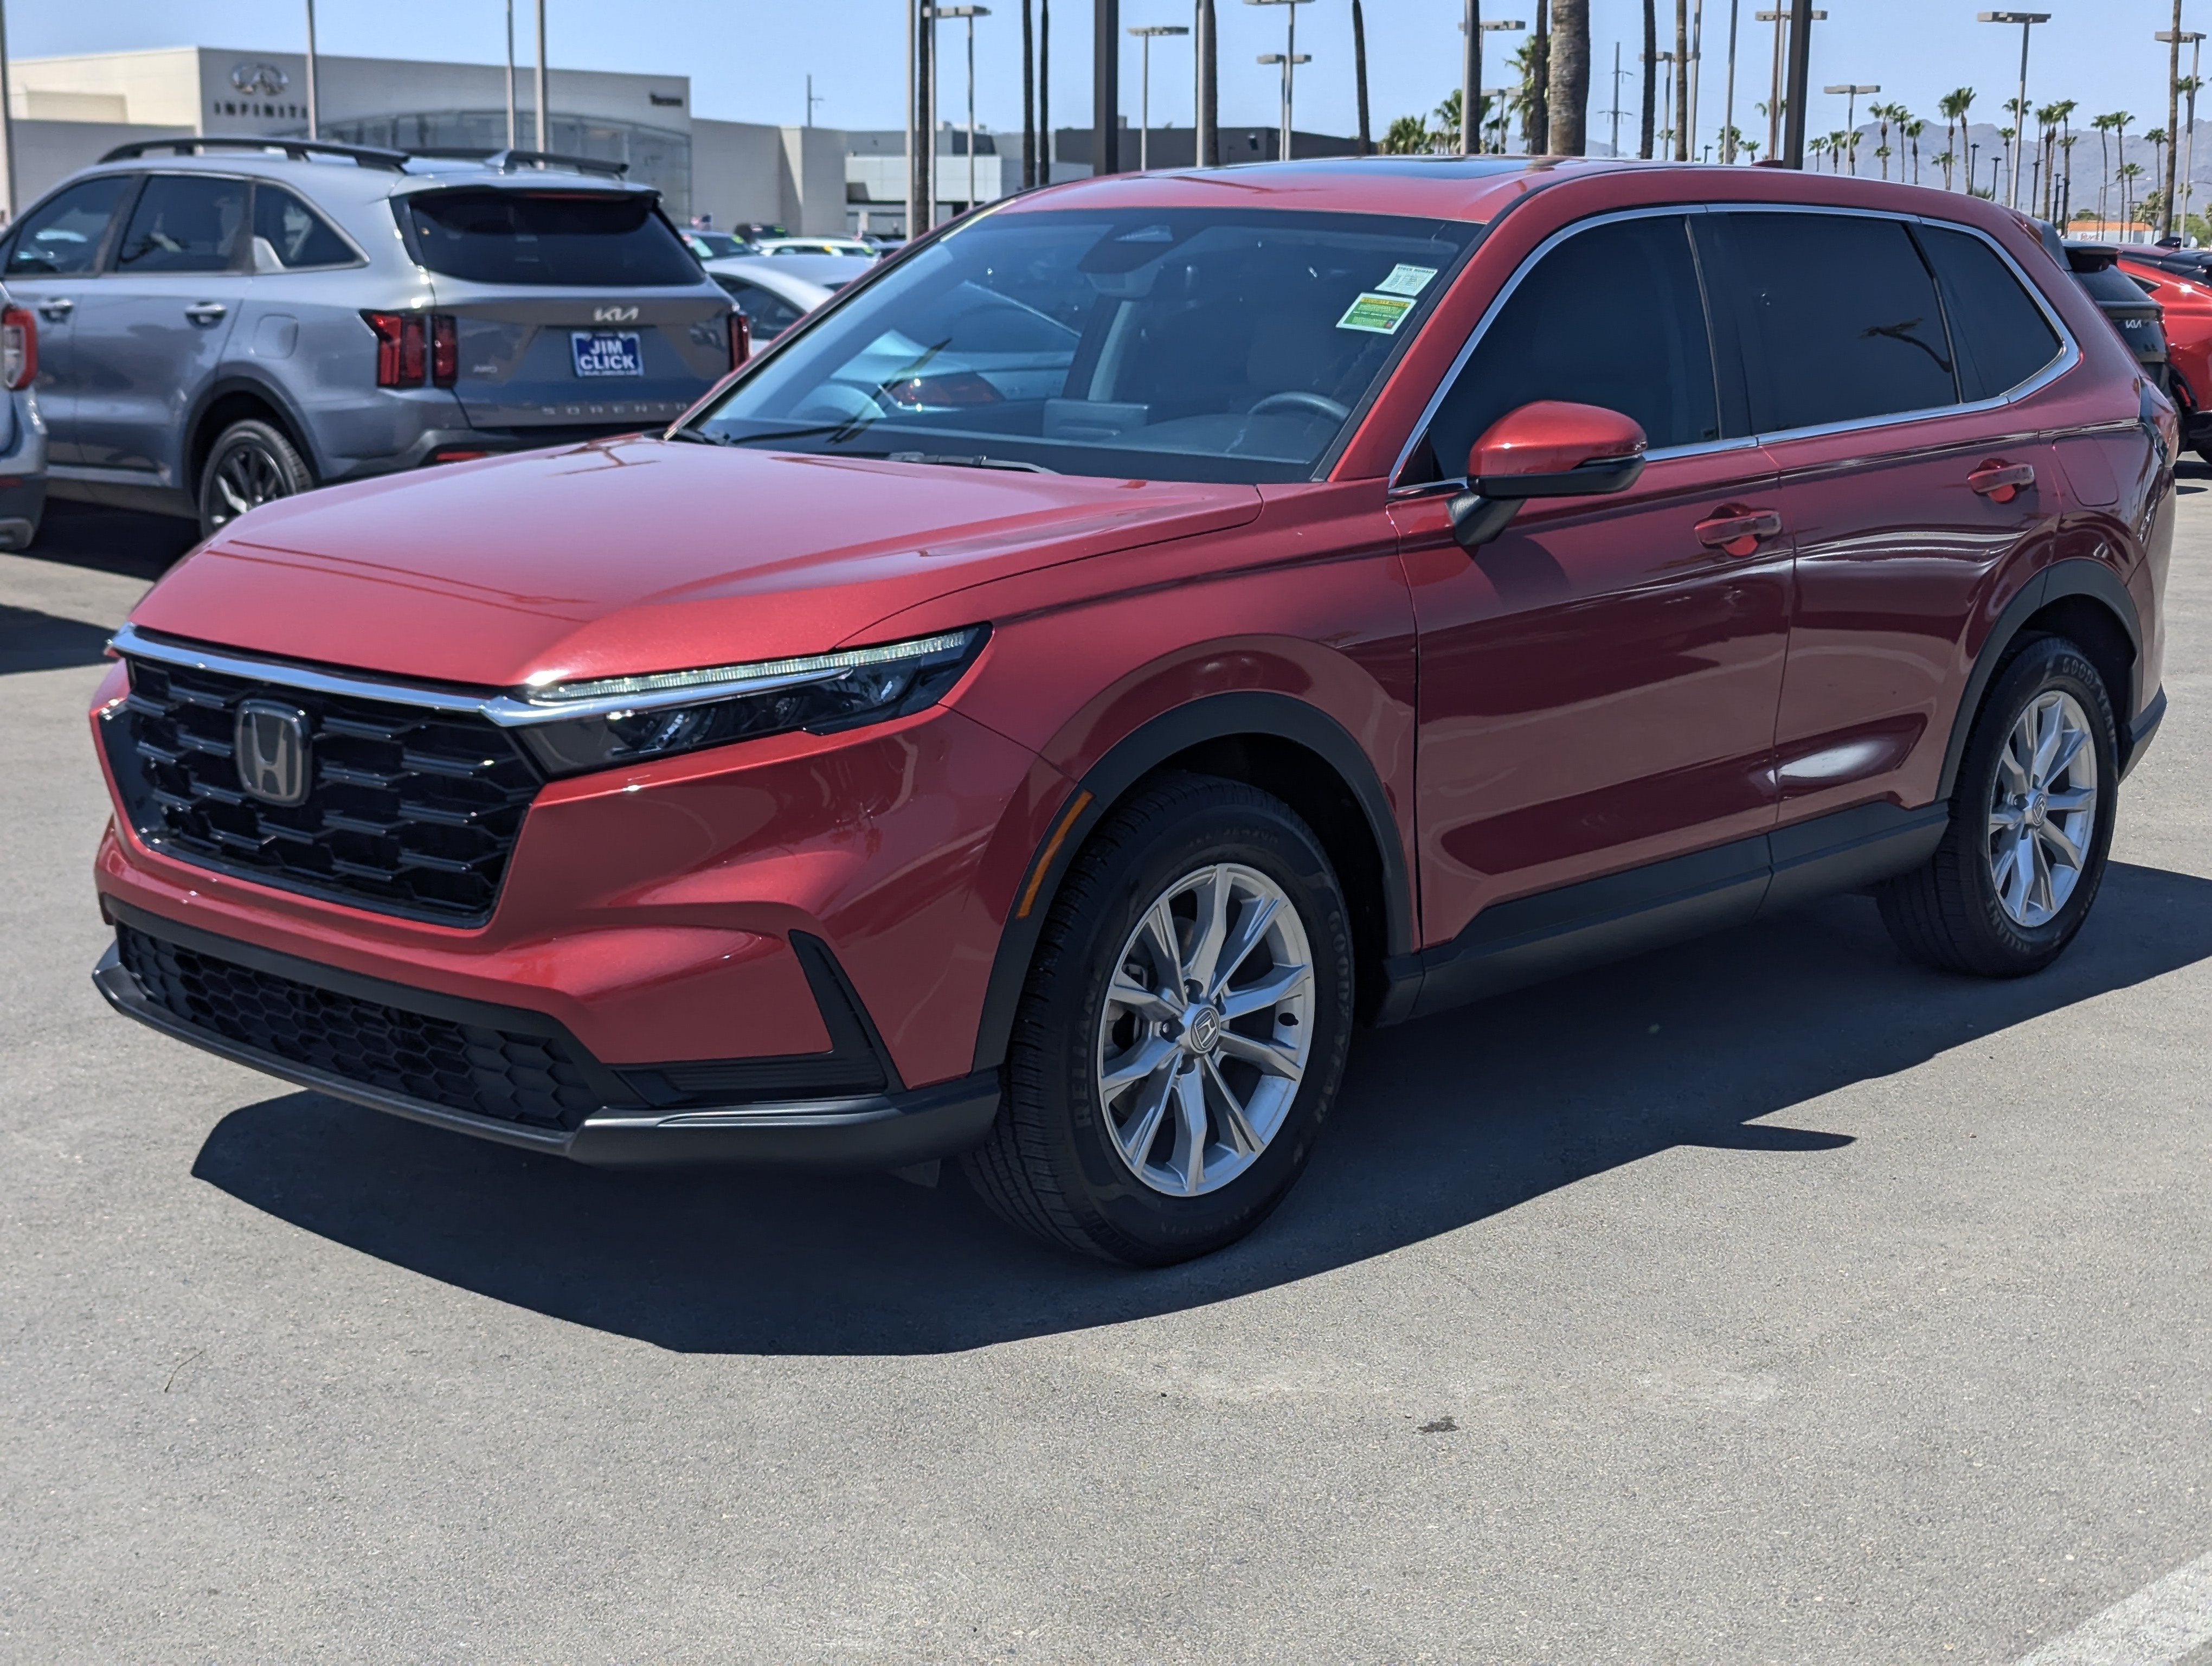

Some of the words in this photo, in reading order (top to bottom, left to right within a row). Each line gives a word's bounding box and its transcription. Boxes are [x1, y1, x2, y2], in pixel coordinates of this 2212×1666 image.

[214, 101, 308, 118] INFINITI
[595, 306, 639, 321] KIA
[2125, 319, 2142, 329] KIA
[590, 340, 623, 355] JIM
[580, 355, 636, 370] CLICK
[542, 402, 688, 415] SORENTO
